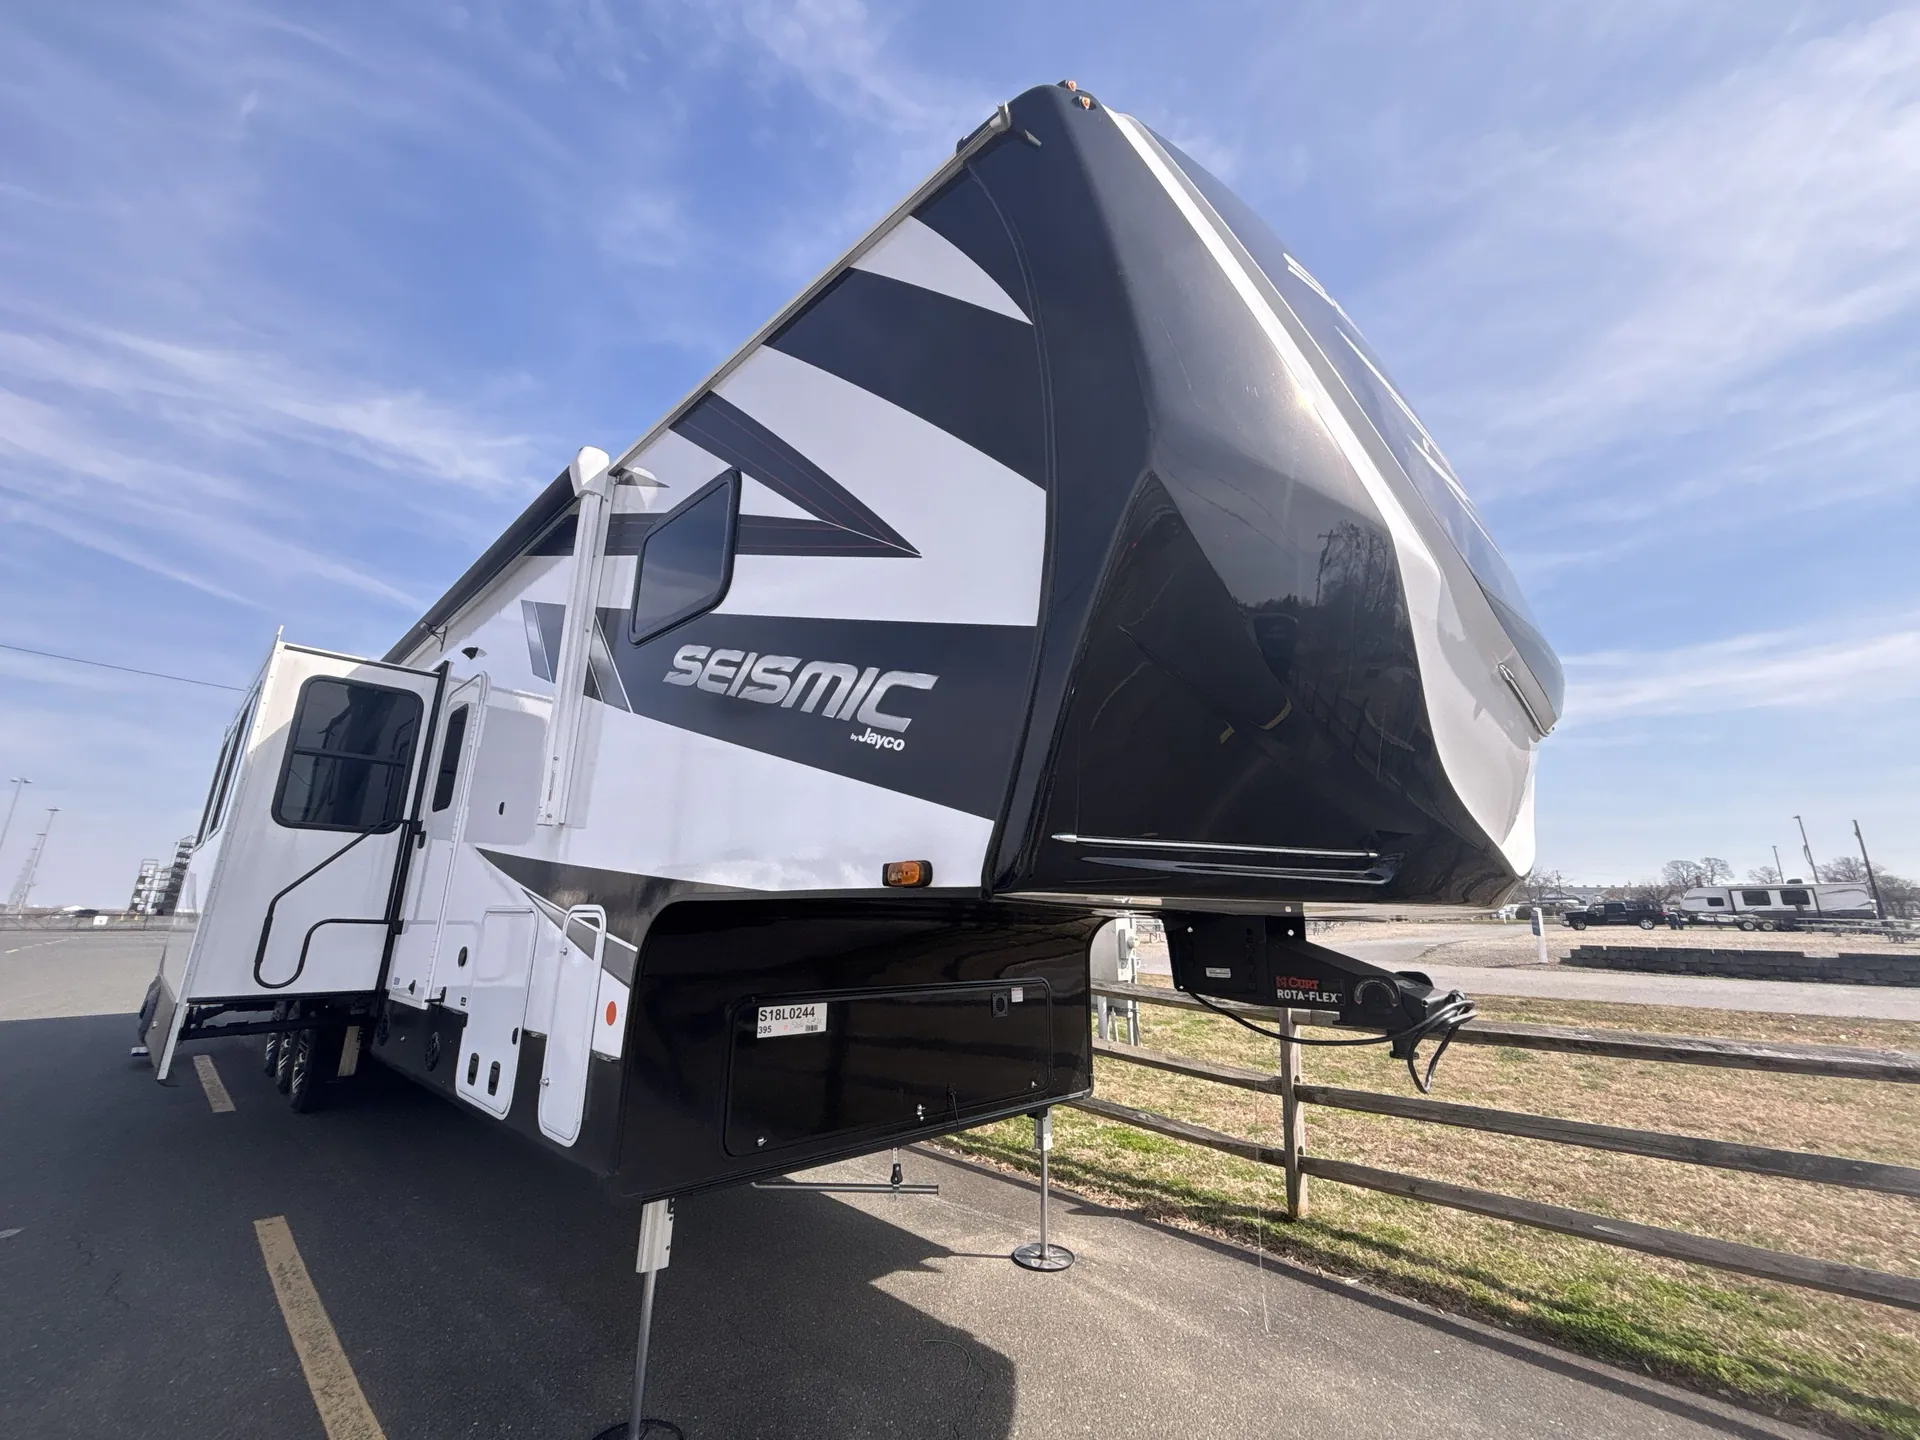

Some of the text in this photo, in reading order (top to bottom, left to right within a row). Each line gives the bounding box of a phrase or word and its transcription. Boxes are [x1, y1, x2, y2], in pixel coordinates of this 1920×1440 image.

[662, 644, 940, 733] SEISMIC
[850, 727, 905, 751] by Jayco
[759, 1006, 816, 1022] S18L0244
[758, 1025, 772, 1034] 395
